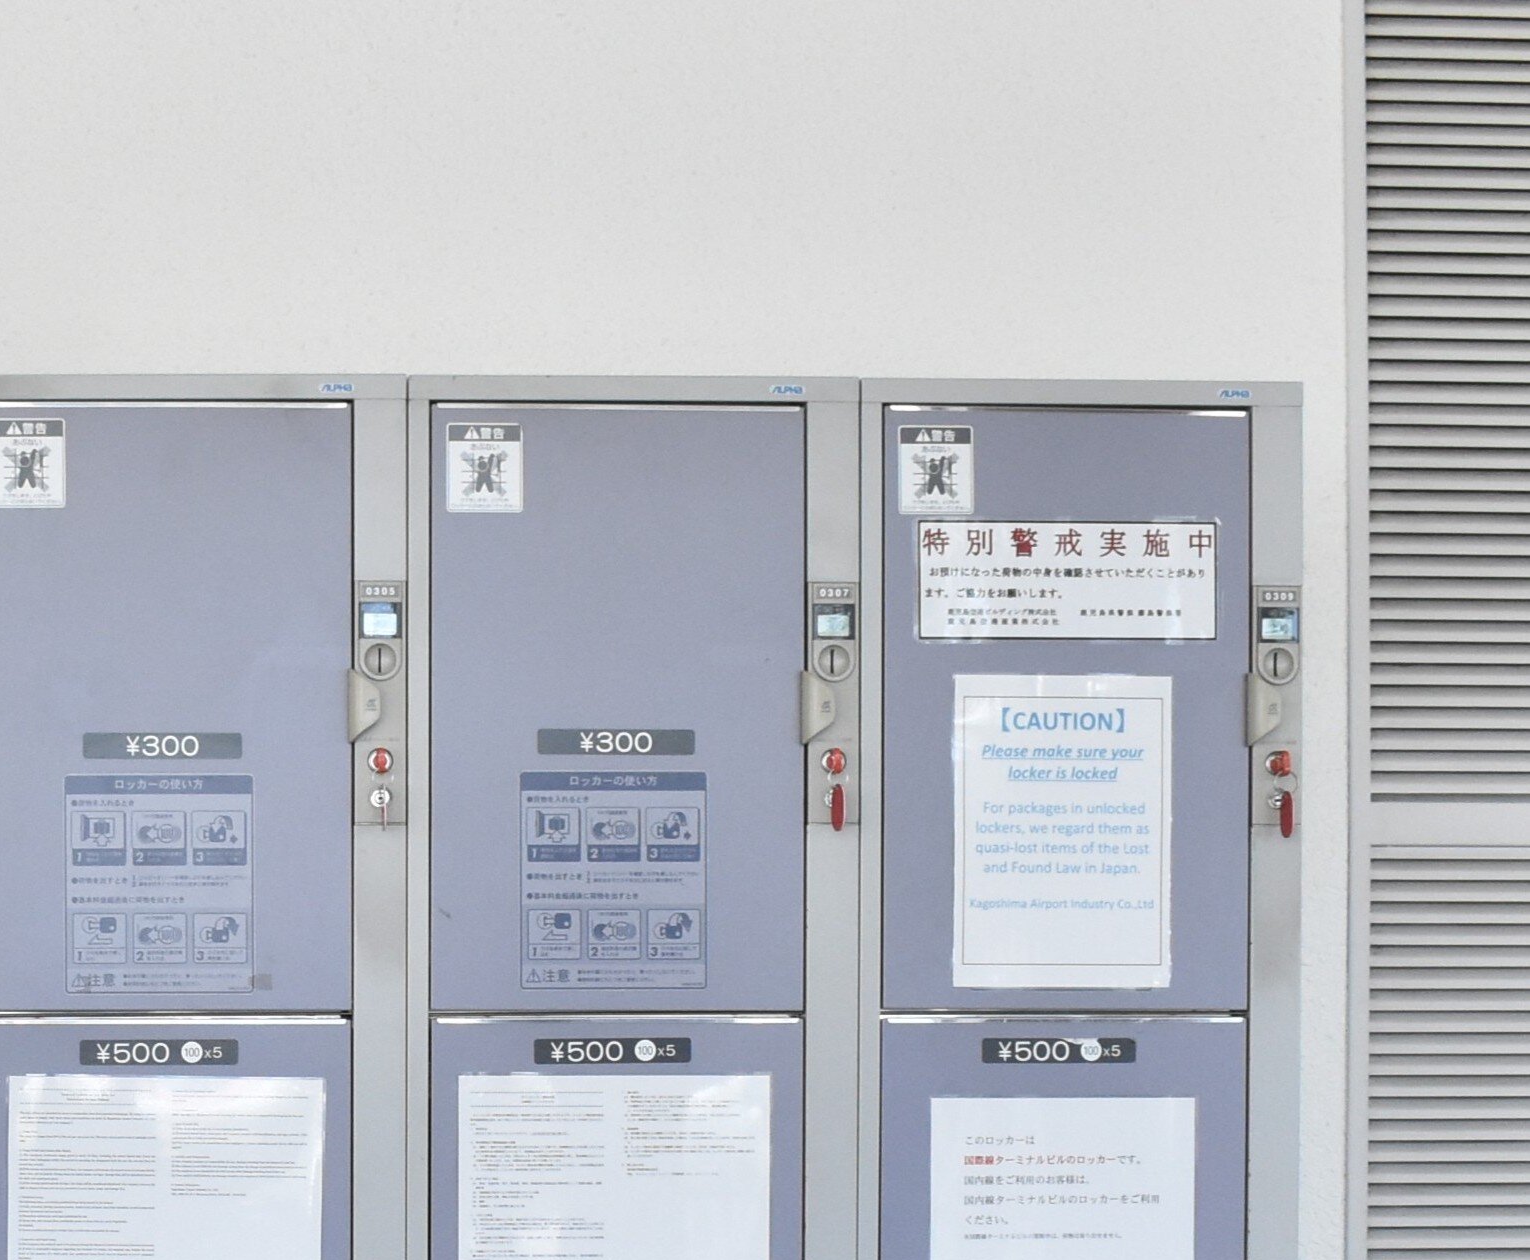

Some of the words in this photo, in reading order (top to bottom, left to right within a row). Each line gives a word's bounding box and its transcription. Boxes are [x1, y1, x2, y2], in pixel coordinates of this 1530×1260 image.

[922, 527, 1213, 558] 特別警戒実施中
[929, 566, 1206, 579] お預けになった荷物の中身を確認させていただくことがあり
[365, 586, 396, 596] 0305
[819, 588, 849, 598] 0307
[925, 587, 1064, 600] ます。ご協力をお願いします。
[1265, 591, 1294, 601] 0309
[1001, 707, 1125, 733] 【CAUTION】
[126, 735, 200, 757] ¥300
[580, 731, 653, 753] ¥300
[982, 744, 1028, 758] Please
[1032, 745, 1072, 758] make
[1077, 748, 1107, 758] sure
[1111, 748, 1144, 761] your
[1008, 765, 1051, 779] locker
[1056, 766, 1067, 779] is
[1071, 766, 1118, 779] locked
[114, 779, 204, 790] ロッカーの使い方
[569, 775, 658, 787] ロッカーの使い方
[983, 802, 1004, 814] For
[1008, 802, 1067, 817] packages
[1072, 802, 1082, 814] in
[1087, 802, 1146, 814] unlocked
[976, 822, 1025, 835] lockers,
[1029, 826, 1048, 834] we
[1052, 824, 1094, 837] regard
[1098, 823, 1132, 834] them
[1136, 826, 1150, 835] as
[975, 842, 1037, 856] quasi-lost
[1042, 842, 1077, 854] items
[1081, 842, 1095, 854] of
[1098, 842, 1119, 854] the
[1123, 843, 1149, 854] Lost
[983, 862, 1007, 873] and
[1012, 862, 1052, 874] Found
[1056, 862, 1081, 874] Law
[1085, 862, 1097, 874] in
[1101, 862, 1140, 876] Japan.
[970, 898, 1027, 911] Kagoshima
[1030, 898, 1068, 910] Airport
[1071, 898, 1115, 910] Industry
[96, 1042, 170, 1064] ¥500
[550, 1041, 624, 1062] ¥500
[998, 1040, 1070, 1062] ¥500
[965, 1135, 1035, 1146] このロッカーは
[964, 1155, 1142, 1165] 国際線ターミナルビルのロッカーです。
[964, 1194, 1160, 1205] 国内線ターミナルビルのロッカーをご利用
[965, 1215, 1009, 1225] ください。
